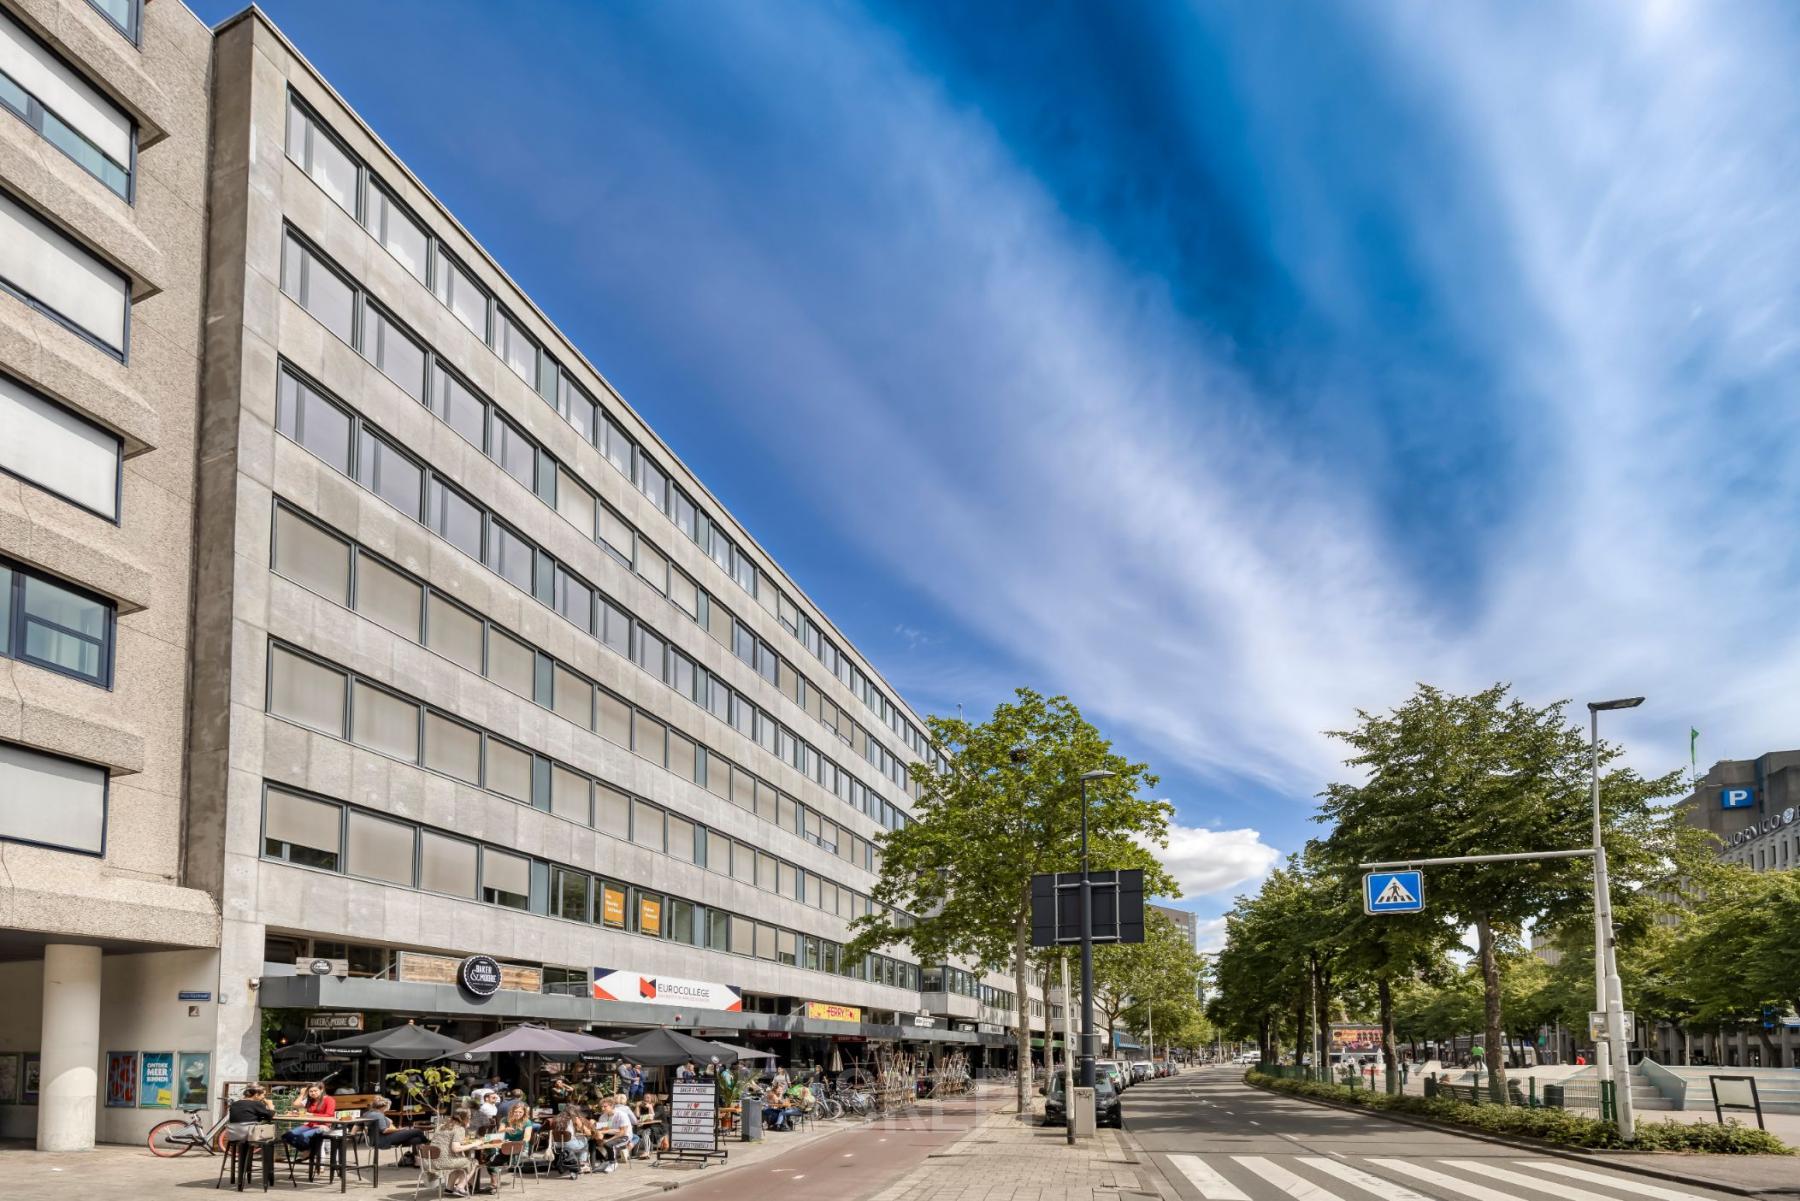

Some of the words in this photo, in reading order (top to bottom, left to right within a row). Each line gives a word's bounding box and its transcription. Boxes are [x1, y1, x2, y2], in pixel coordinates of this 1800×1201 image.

[1729, 790, 1748, 806] P
[475, 965, 493, 974] BAKER
[479, 973, 497, 983] MOORE
[657, 983, 710, 998] EUROCOLLEGE
[826, 1005, 845, 1018] FERRY
[147, 1068, 168, 1077] MEER
